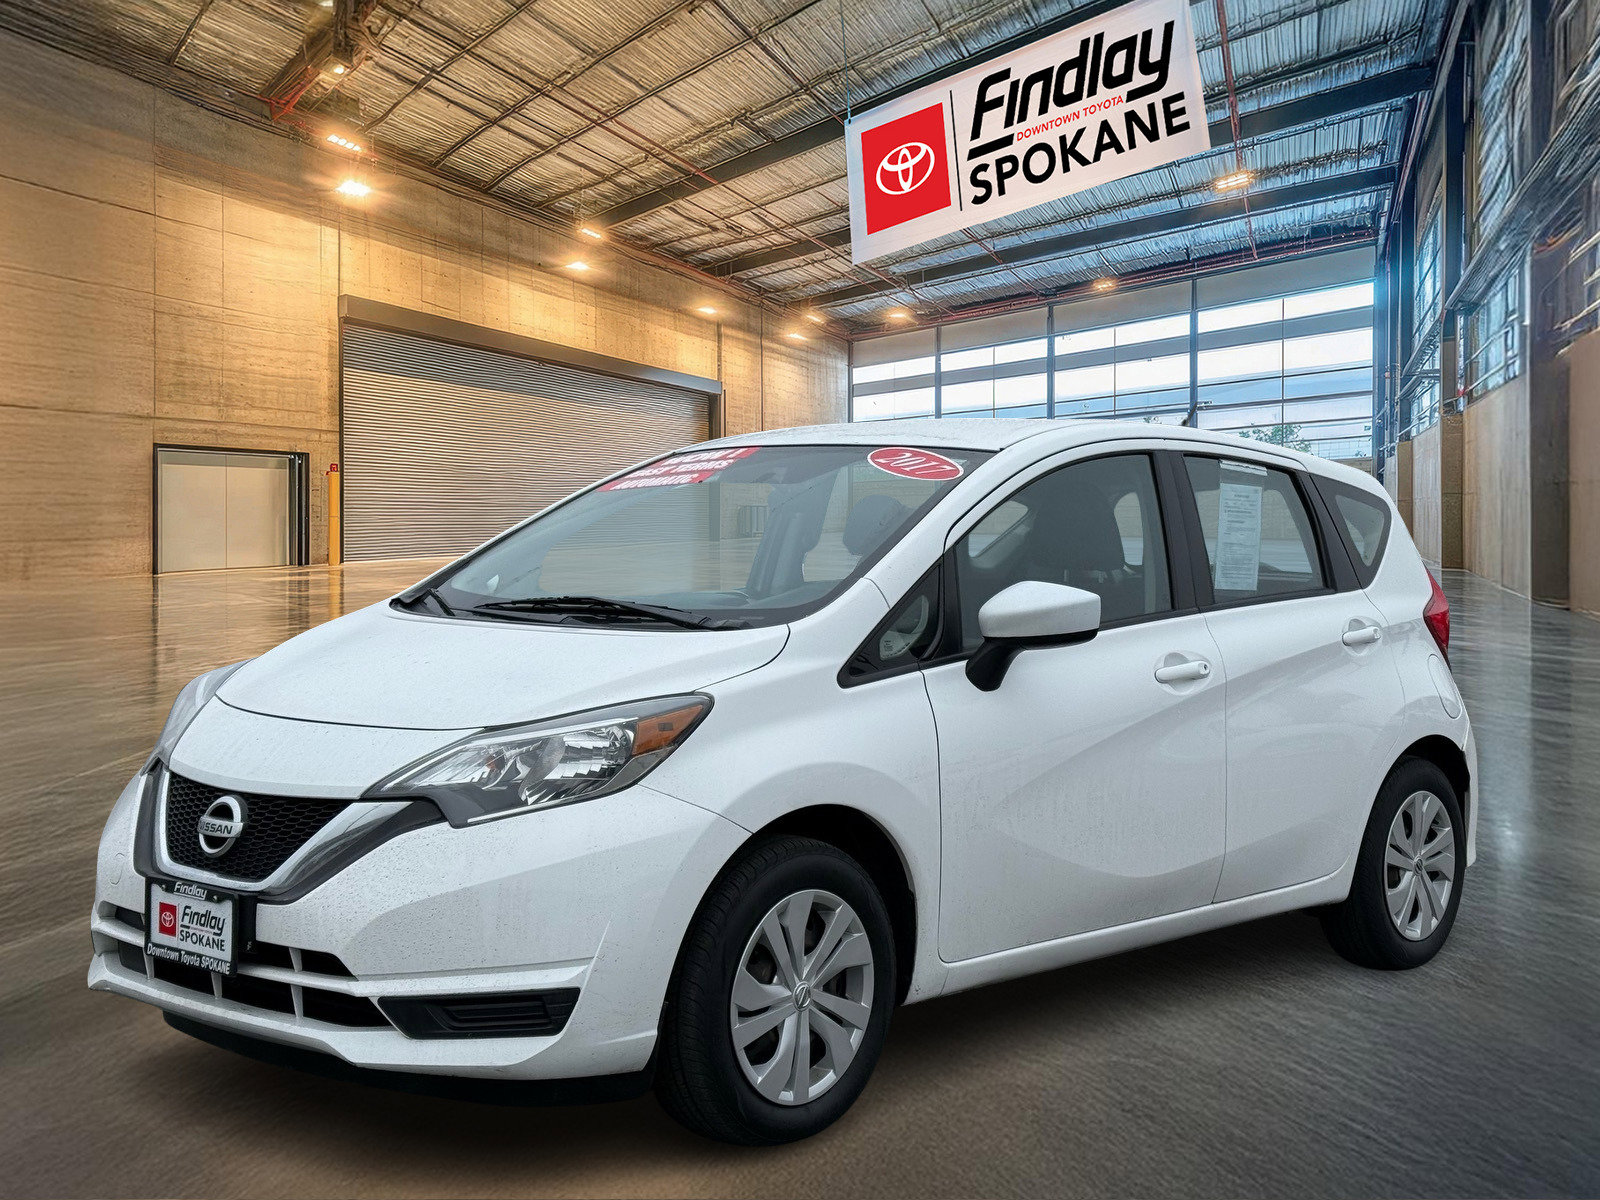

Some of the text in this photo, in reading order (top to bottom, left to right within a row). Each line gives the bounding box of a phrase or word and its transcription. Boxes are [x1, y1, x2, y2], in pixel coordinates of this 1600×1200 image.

[970, 20, 1175, 142] Findlay
[1016, 95, 1124, 142] DOWNTOWN TOYOTA
[969, 92, 1191, 205] SPOKANE
[874, 452, 957, 475] 2017
[174, 882, 207, 900] Findlay
[181, 905, 226, 937] Findlay
[180, 929, 226, 952] SPOKANE
[147, 943, 231, 975] Downtown Toyota SPOKANE
